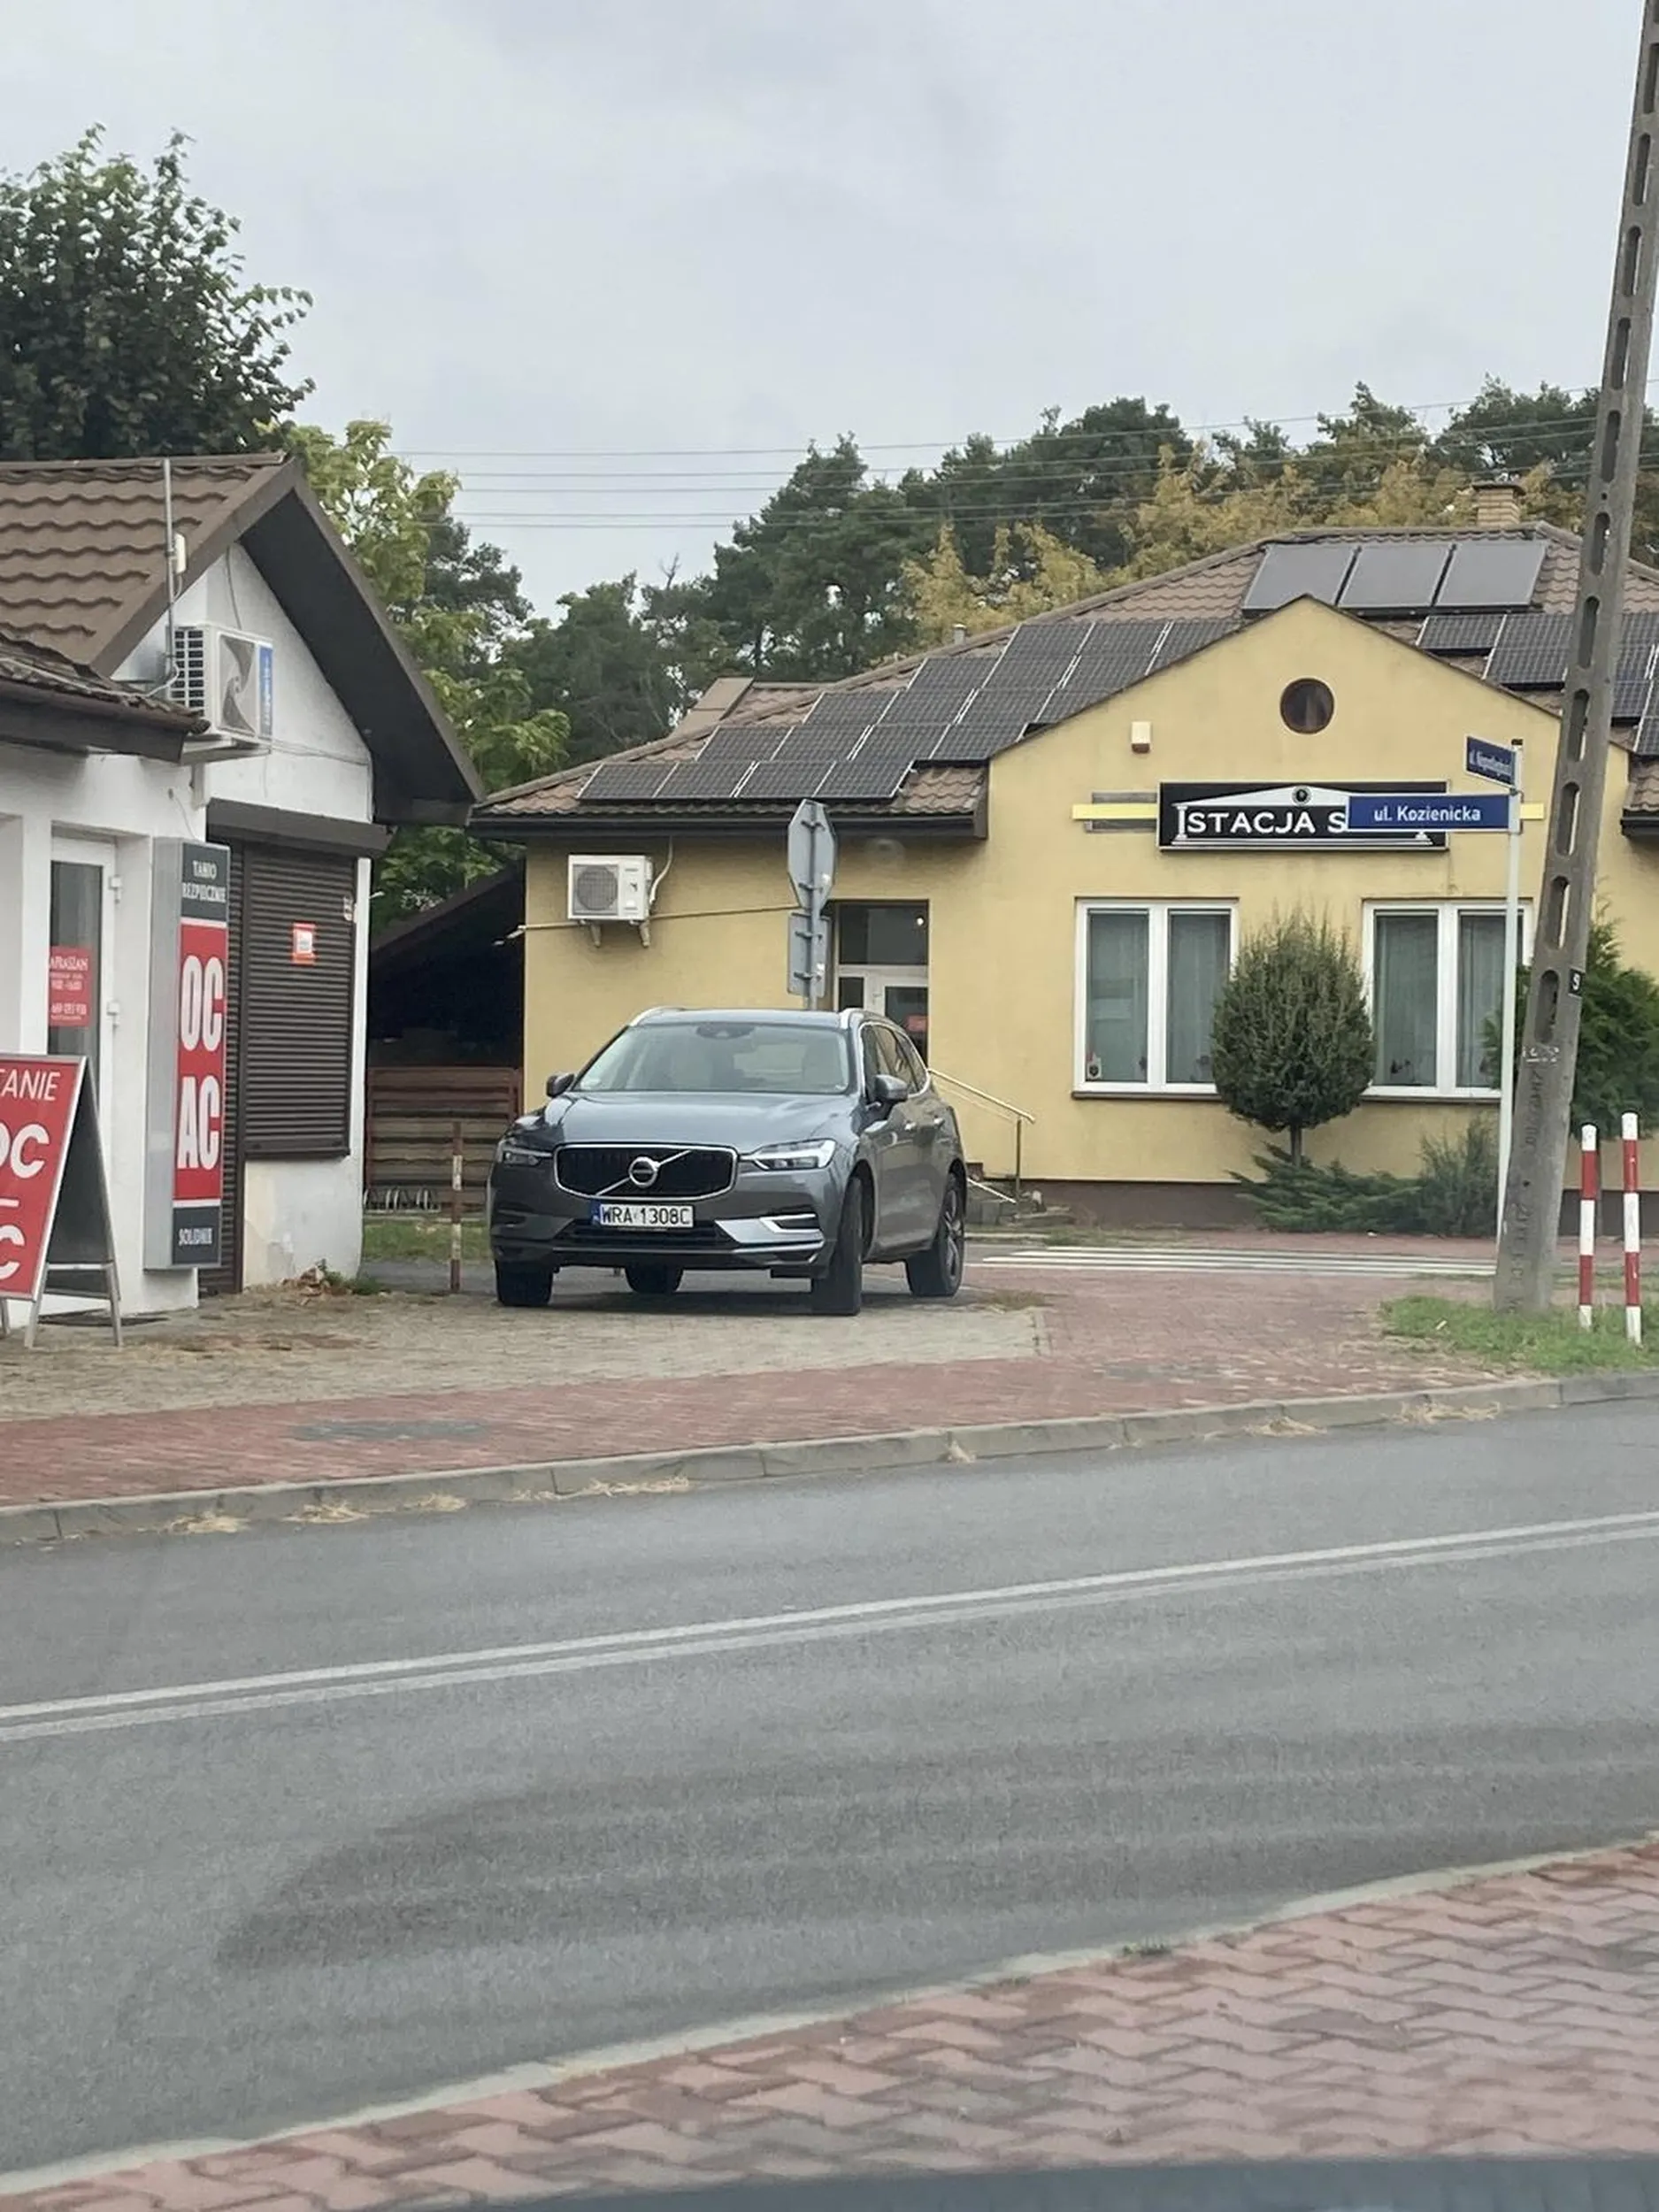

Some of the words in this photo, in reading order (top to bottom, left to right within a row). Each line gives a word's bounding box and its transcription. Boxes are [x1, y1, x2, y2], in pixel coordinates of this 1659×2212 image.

[1187, 811, 1316, 833] STACJA
[1374, 806, 1393, 821] ul.
[1397, 805, 1480, 821] Kozienicka
[180, 955, 223, 1052] OC
[0, 1068, 60, 1102] ANIE
[178, 1075, 220, 1170] AC
[603, 1207, 633, 1224] WRA
[641, 1208, 690, 1225] 1308C
